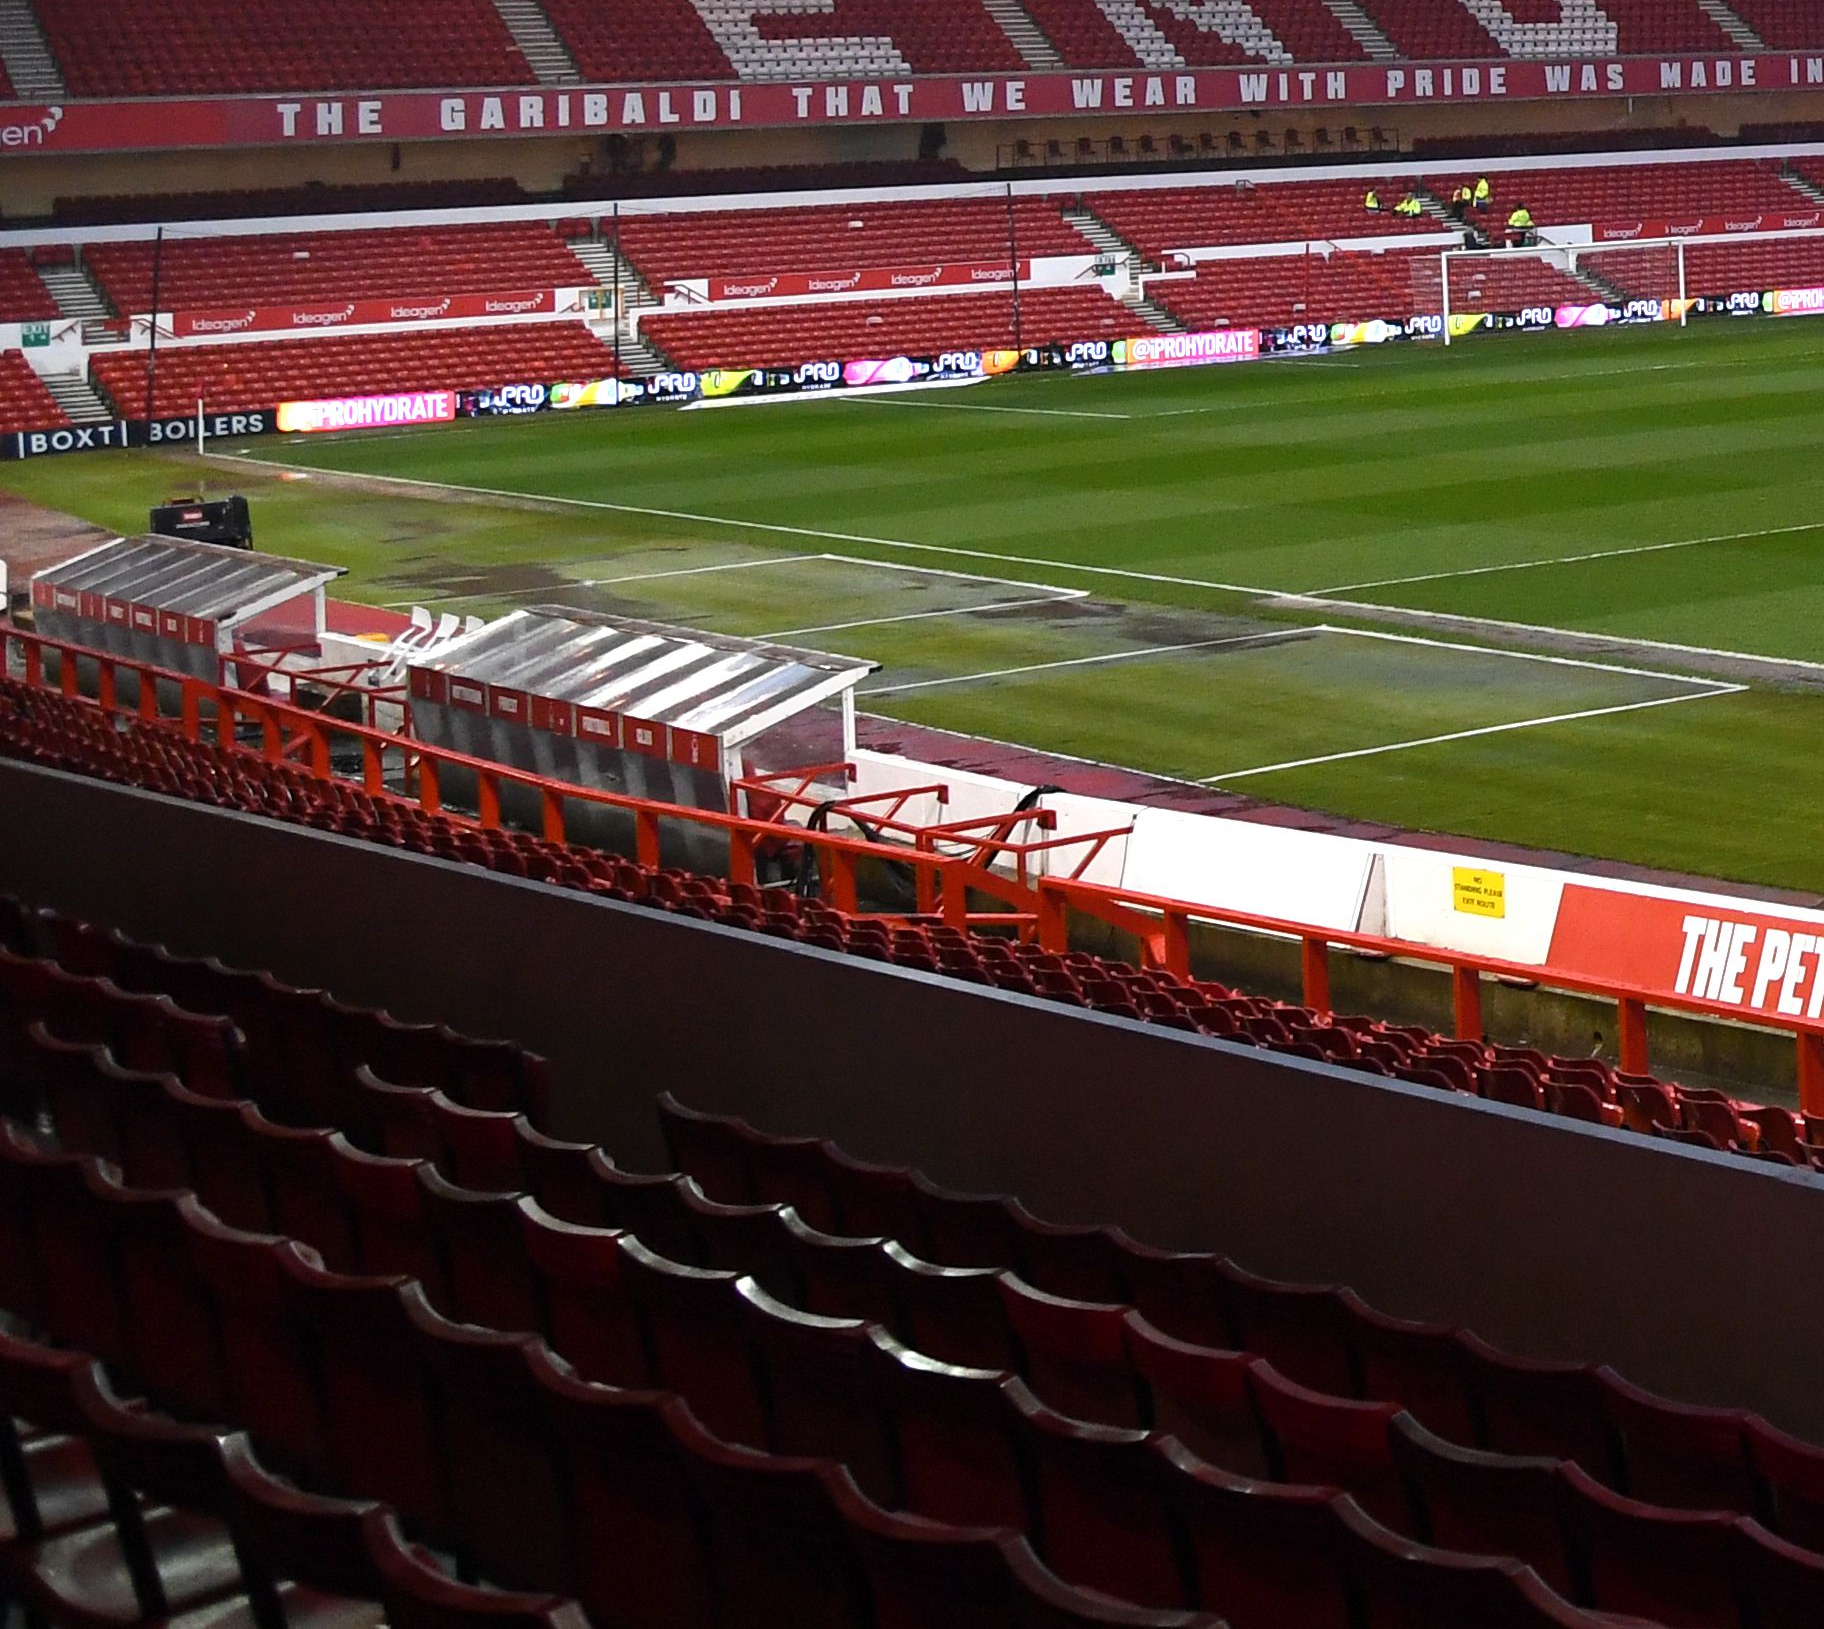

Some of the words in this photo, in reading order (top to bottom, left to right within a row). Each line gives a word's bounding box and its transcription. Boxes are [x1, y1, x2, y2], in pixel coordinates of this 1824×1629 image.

[277, 101, 383, 136] THE
[440, 90, 740, 132] GARIBALDI
[793, 84, 913, 118] THAT
[962, 82, 1026, 112] WE
[1072, 76, 1196, 108] WEAR
[1239, 71, 1346, 102] WITH
[1387, 67, 1507, 98] PRIDE
[1545, 64, 1624, 93] WAS
[1660, 59, 1756, 88] MADE
[1791, 57, 1823, 82] IN
[1725, 220, 1760, 233] Ideagen
[1784, 216, 1817, 229] Ideagen
[1603, 226, 1640, 239] Ideagen
[891, 273, 937, 287] Ideagen
[971, 267, 1014, 281] Ideagen
[723, 283, 772, 297] Ideagen
[808, 278, 856, 292] Ideagen
[391, 304, 444, 319] Ideagen
[485, 298, 536, 313] Ideagen
[192, 318, 248, 333] Ideagen
[293, 312, 347, 326] Ideagen
[22, 323, 49, 334] EXIT
[31, 426, 115, 453] BOXT
[150, 414, 264, 442] BOILERS
[1675, 915, 1757, 1004] THE
